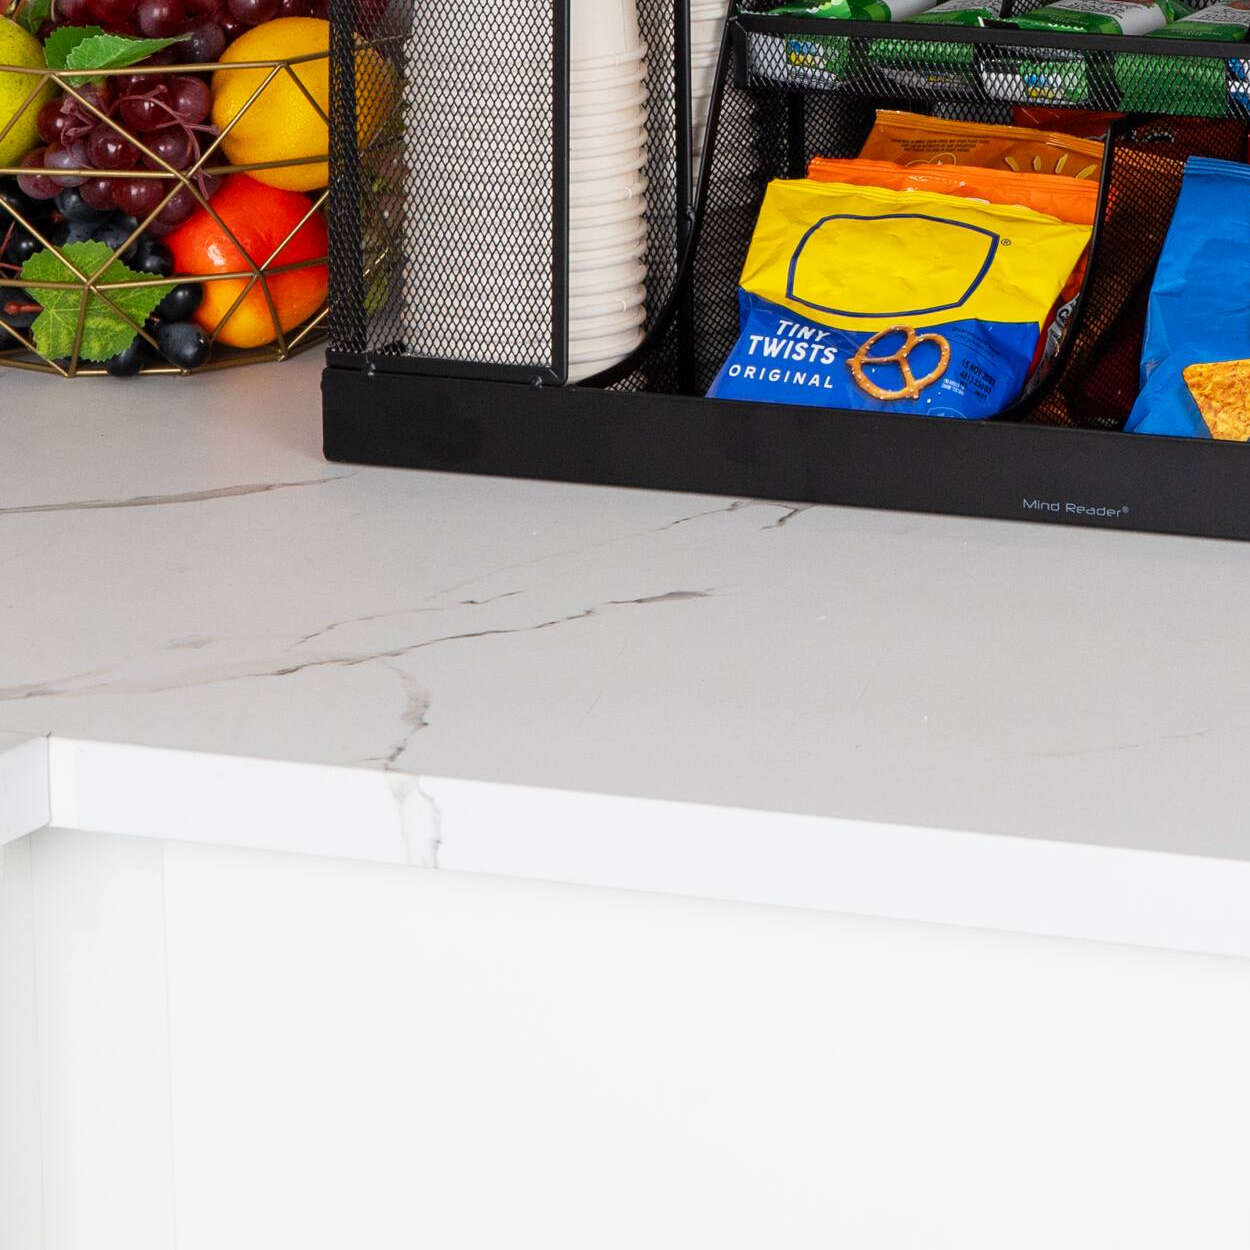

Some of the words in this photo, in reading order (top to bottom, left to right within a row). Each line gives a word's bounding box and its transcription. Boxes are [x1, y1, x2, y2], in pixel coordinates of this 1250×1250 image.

[776, 320, 831, 342] TINY
[748, 335, 838, 365] TWISTS
[728, 364, 834, 389] ORIGINAL
[1022, 499, 1060, 512] Mind
